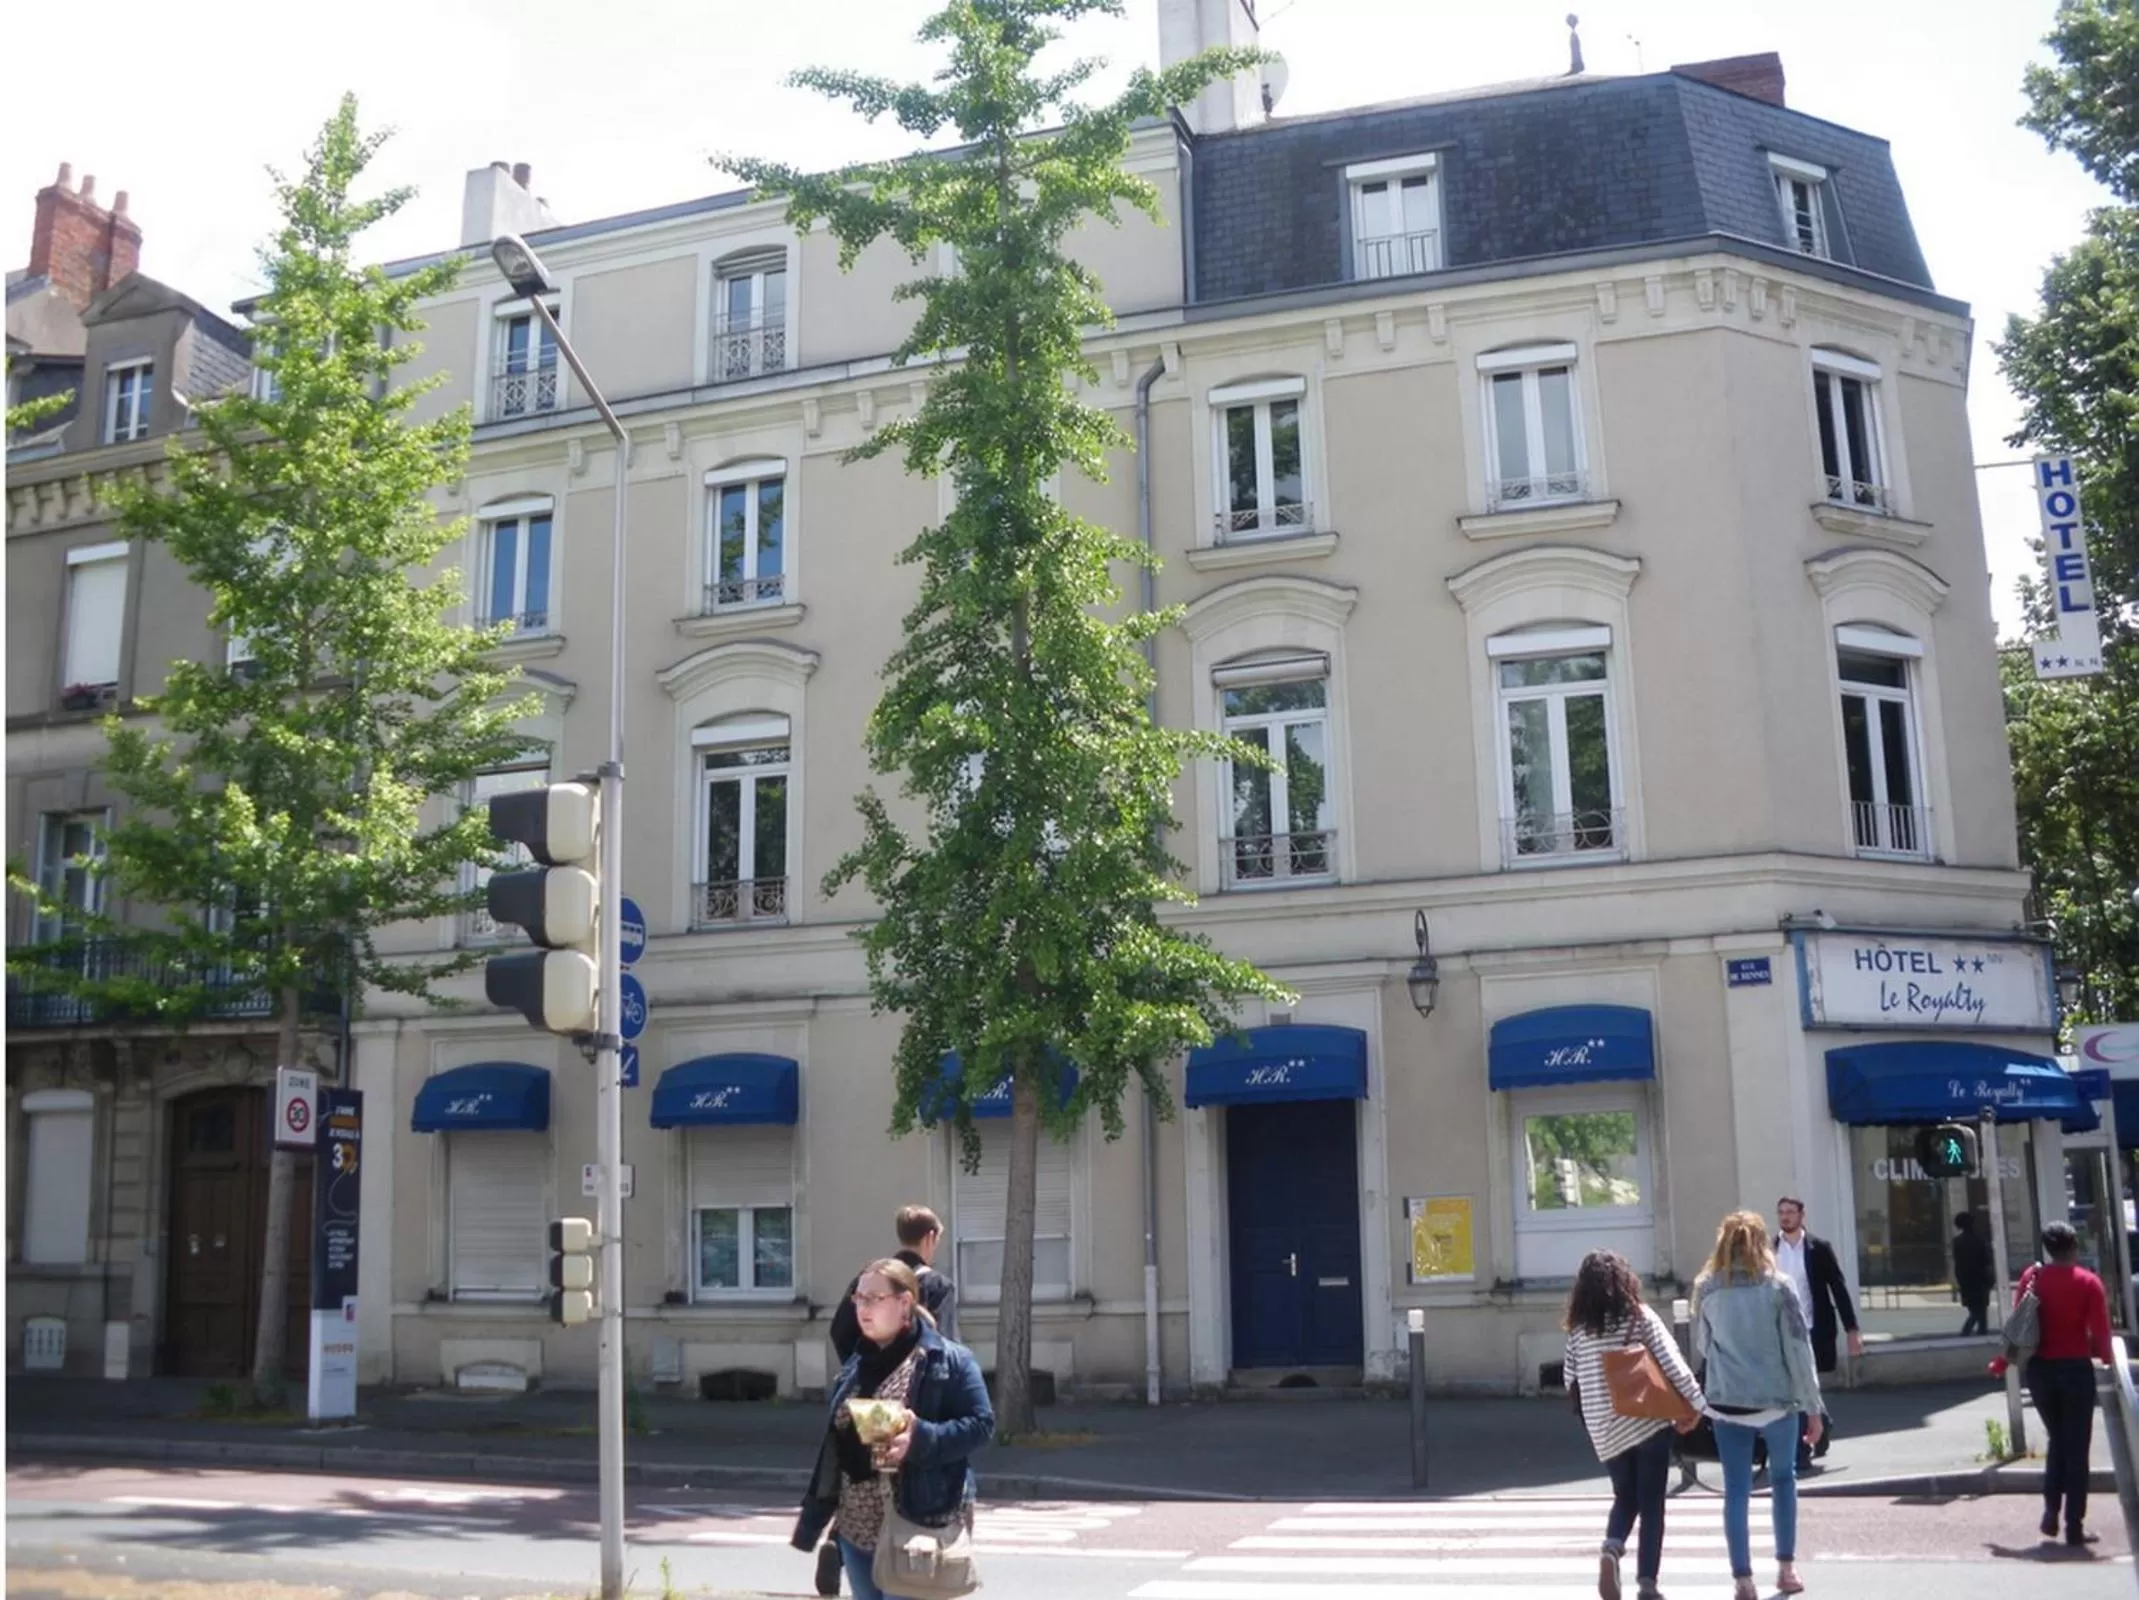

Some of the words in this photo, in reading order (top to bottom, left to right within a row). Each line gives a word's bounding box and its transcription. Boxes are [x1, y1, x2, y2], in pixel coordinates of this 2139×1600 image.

[2040, 459, 2090, 613] HOTEL
[1854, 944, 1943, 974] HÔTEL
[1880, 980, 1900, 1012] Le
[1906, 981, 1987, 1022] Royalty
